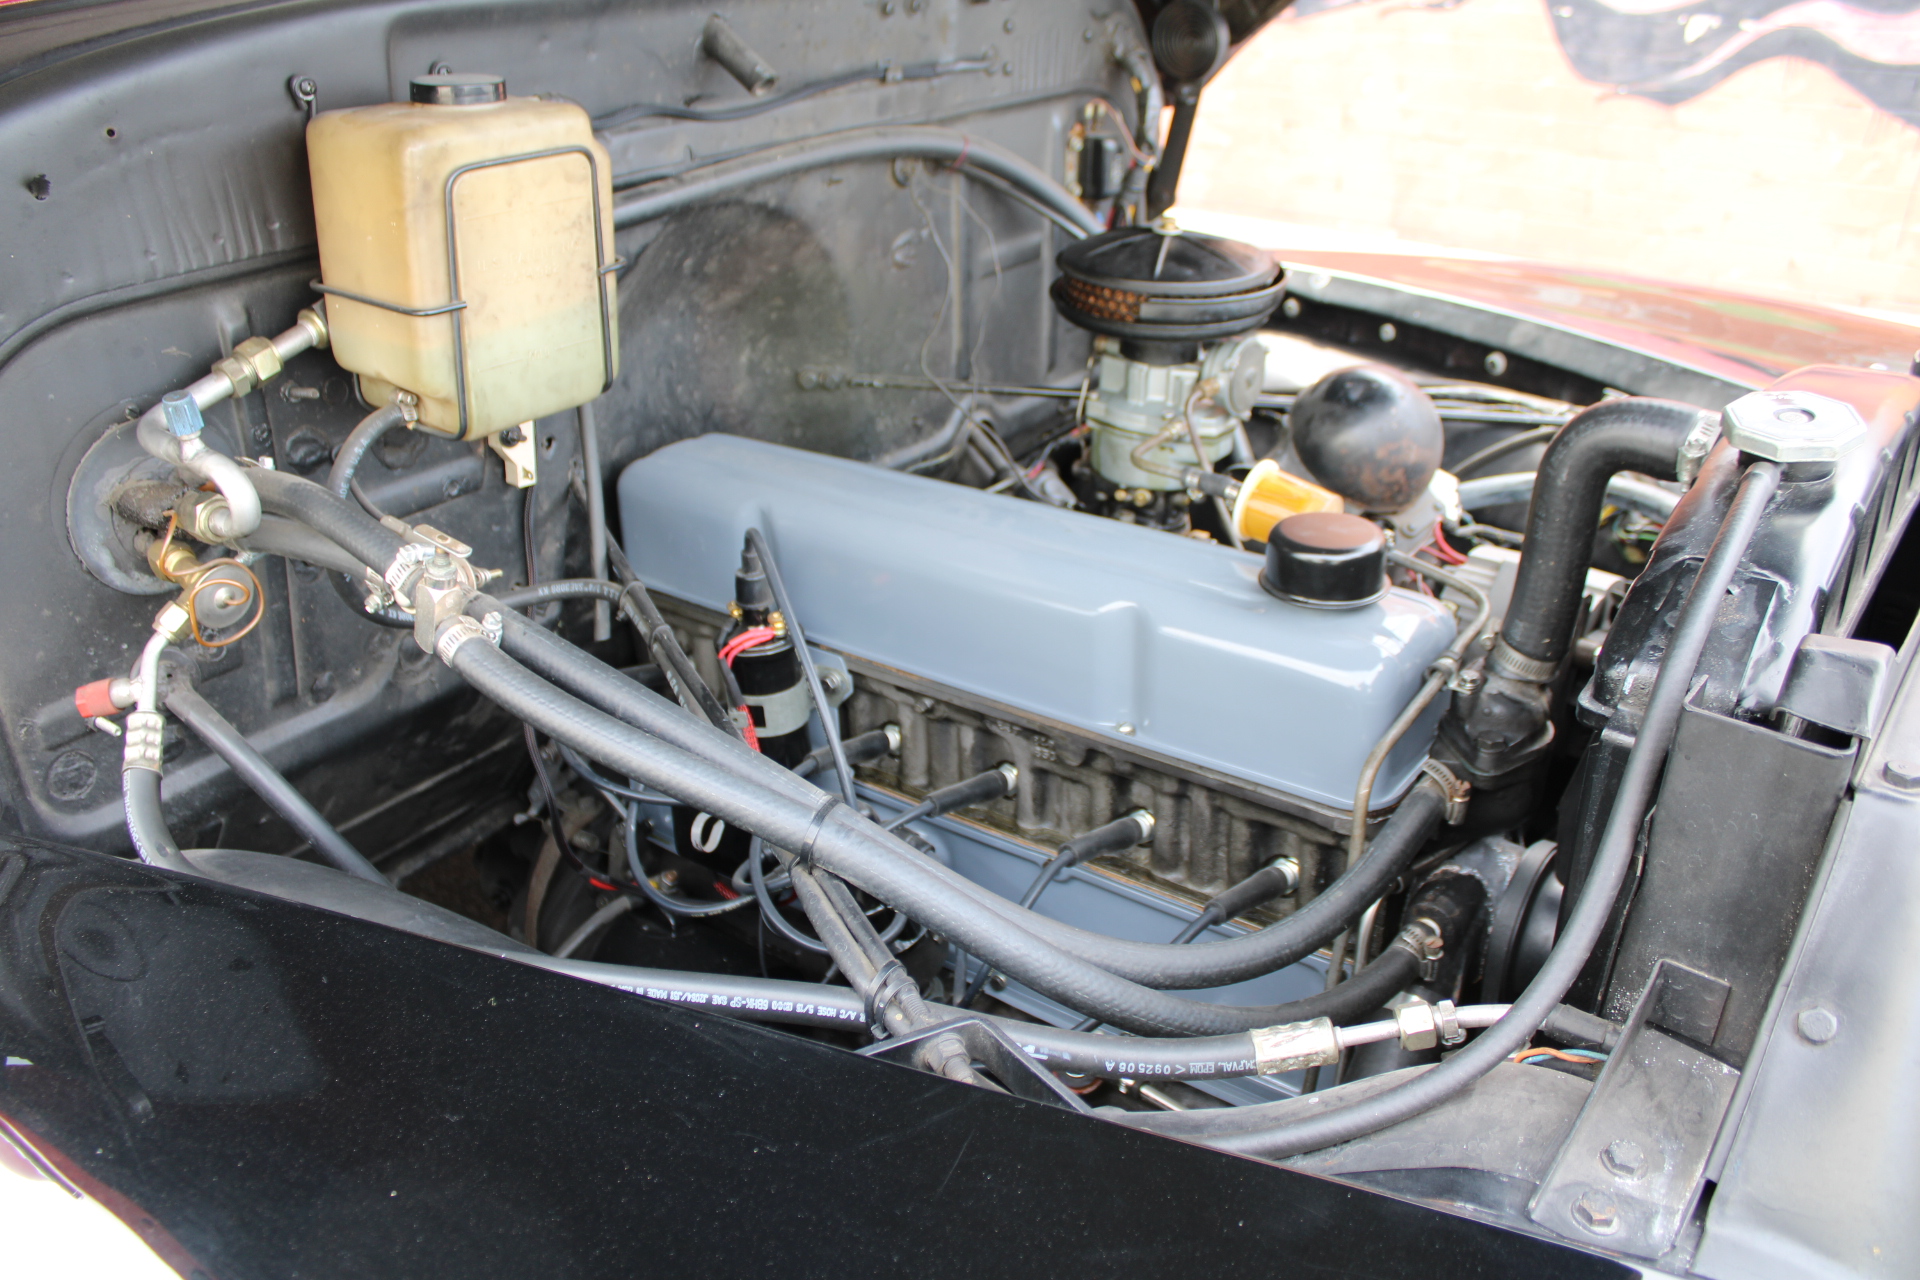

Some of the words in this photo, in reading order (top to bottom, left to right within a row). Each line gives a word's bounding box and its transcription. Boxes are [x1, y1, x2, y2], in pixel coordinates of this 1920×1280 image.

[646, 988, 668, 1000] MADE
[711, 995, 728, 1006] SAE
[817, 1004, 837, 1017] HOSE
